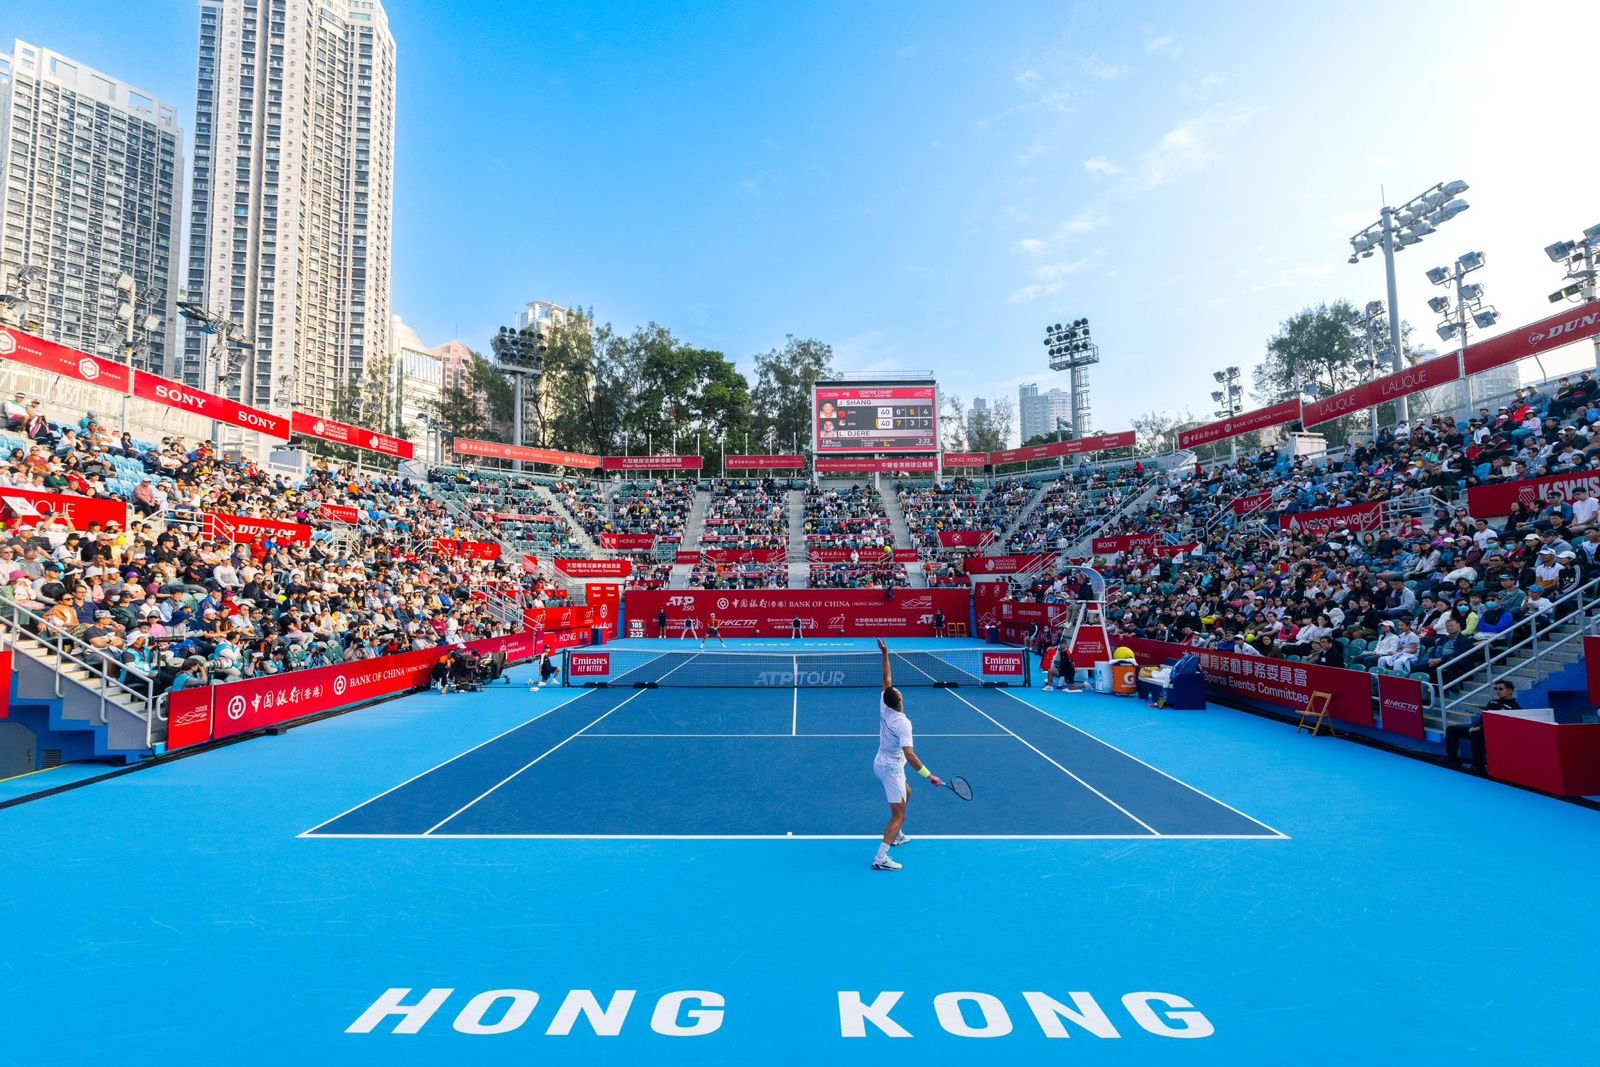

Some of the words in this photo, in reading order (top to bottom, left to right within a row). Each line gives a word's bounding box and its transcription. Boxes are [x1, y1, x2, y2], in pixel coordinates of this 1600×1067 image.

[1546, 311, 1600, 339] DUN
[1382, 370, 1426, 395] LALIQUE
[156, 385, 206, 409] SONY
[1320, 395, 1356, 416] LALIQUE
[238, 411, 276, 430] SONY
[1255, 415, 1272, 423] CHINA
[1130, 538, 1152, 546] SONY
[666, 596, 695, 606] ATP
[916, 614, 936, 624] AT
[559, 633, 576, 641] KONG
[572, 656, 608, 665] Emirates
[984, 656, 1020, 665] Emirates
[350, 674, 371, 688] BANK
[372, 672, 382, 682] OF
[383, 668, 405, 680] CHINA
[798, 671, 845, 685] TOUR
[1203, 671, 1227, 684] Sports
[1228, 676, 1256, 692] Events
[1258, 682, 1310, 704] Committee
[344, 988, 726, 1036] HONG
[837, 991, 1215, 1038] KONG
